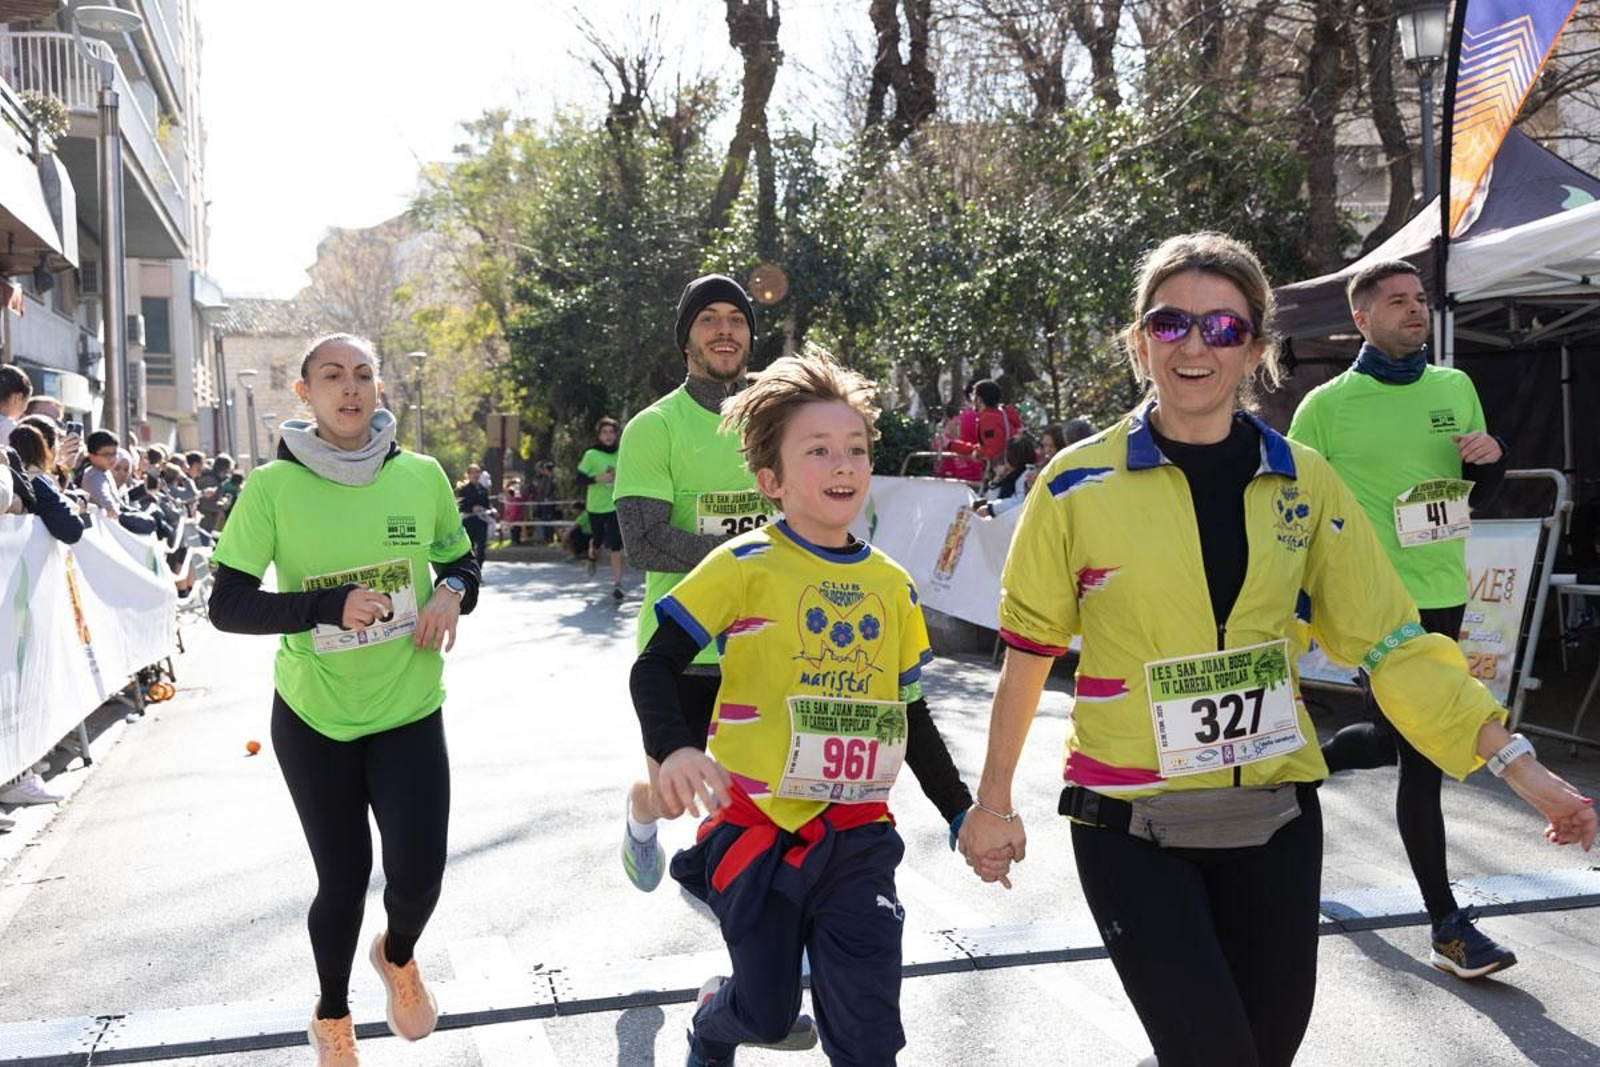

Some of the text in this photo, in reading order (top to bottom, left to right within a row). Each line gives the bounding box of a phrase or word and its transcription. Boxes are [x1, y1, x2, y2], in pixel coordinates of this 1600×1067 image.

[1426, 501, 1448, 526] 41
[821, 581, 861, 590] CLUB
[1176, 662, 1197, 677] SAN
[1200, 657, 1226, 675] JUAN
[1228, 653, 1252, 669] BOSCO
[1160, 669, 1248, 694] IV CARRERA POPULAR
[814, 701, 829, 716] SAN
[831, 703, 853, 717] JUAN
[855, 704, 878, 719] BOSCO
[1190, 687, 1266, 744] 327
[810, 715, 838, 732] CARRERA
[840, 717, 870, 733] POPULAR
[822, 736, 880, 781] 961
